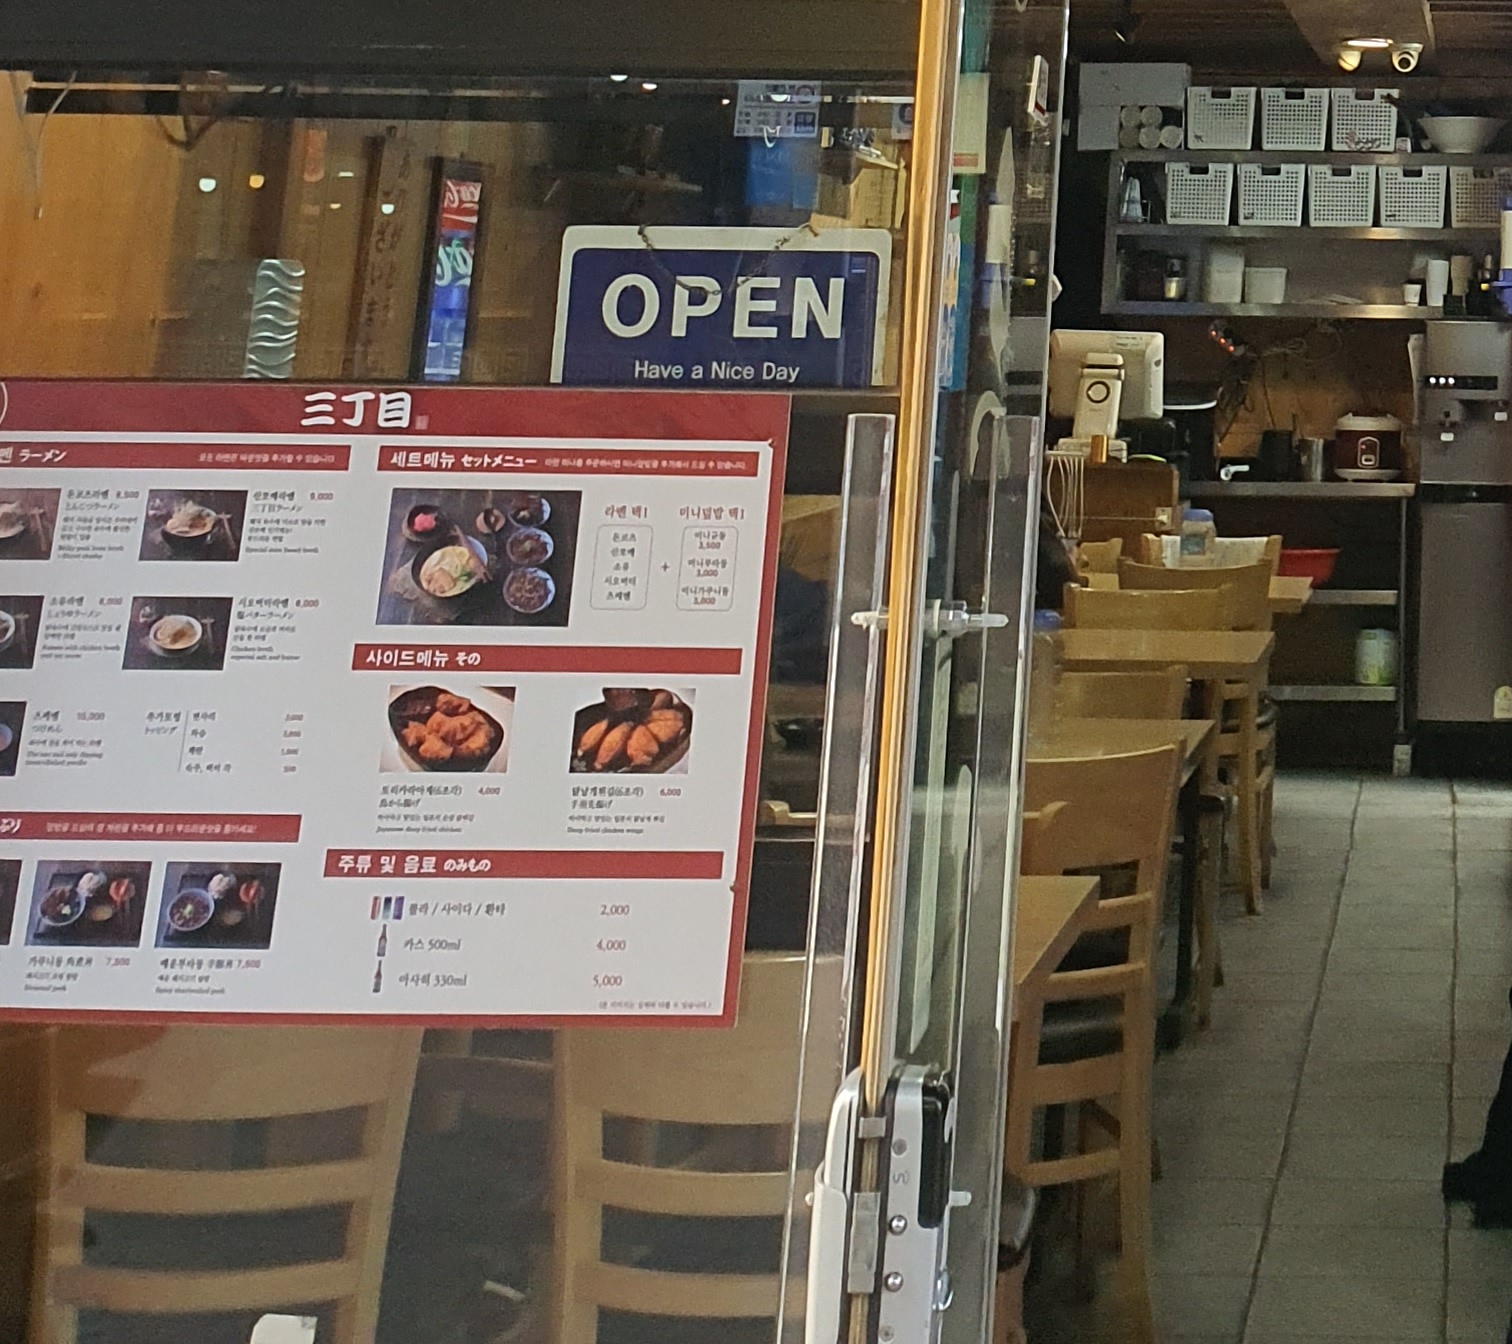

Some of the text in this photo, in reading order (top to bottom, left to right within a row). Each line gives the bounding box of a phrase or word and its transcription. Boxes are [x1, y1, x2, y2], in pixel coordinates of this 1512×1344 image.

[601, 273, 846, 340] OPEN
[633, 361, 800, 383] Have a Nice Day
[300, 390, 412, 429] 三丁目
[19, 448, 68, 463] ラーメン
[390, 451, 456, 468] 세트메뉴
[460, 453, 538, 468] セットメニュー
[366, 649, 481, 668] 사이드메뉴 その
[338, 854, 492, 874] 주류 및 음료 のみもの
[600, 903, 630, 916] 2,000
[427, 938, 462, 951] 500ml
[595, 939, 627, 952] 4,000
[433, 973, 468, 987] 330ml
[592, 974, 623, 988] 5,000
